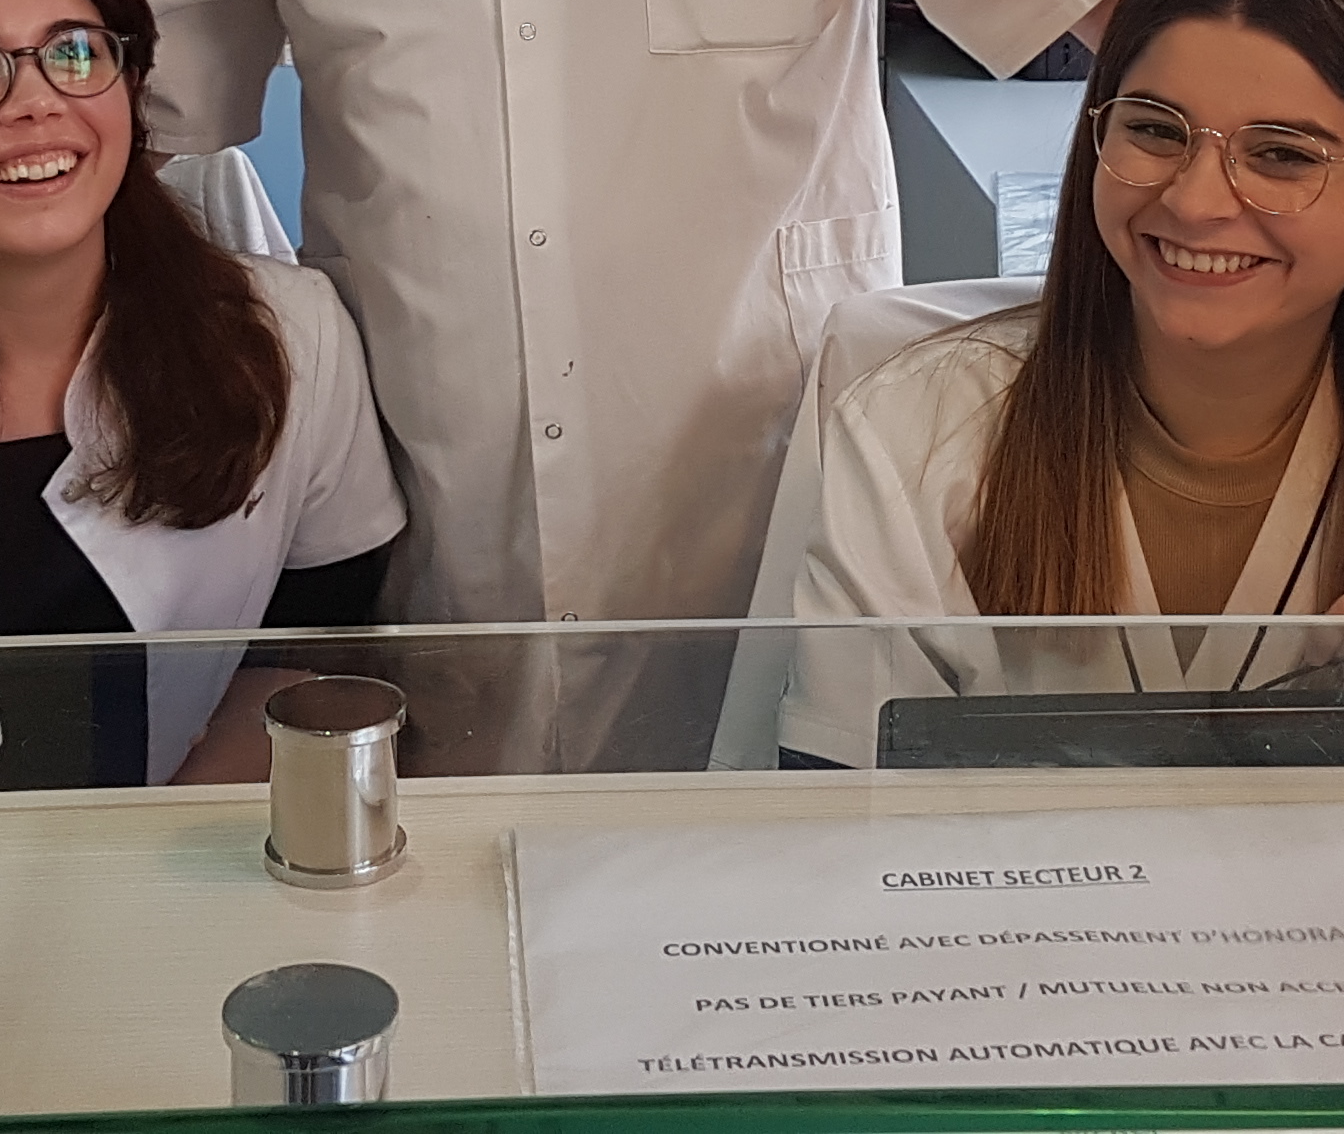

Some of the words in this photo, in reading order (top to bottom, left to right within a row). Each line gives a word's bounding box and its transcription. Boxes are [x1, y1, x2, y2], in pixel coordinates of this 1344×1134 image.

[882, 870, 995, 888] CABINET
[1003, 865, 1124, 885] SECTEUR
[1129, 864, 1147, 880] 2
[662, 934, 890, 957] CONVENTIONNÉ
[899, 934, 972, 950] AVEC
[978, 928, 1182, 947] DÉPASSEMENT
[695, 997, 750, 1012] PAS
[758, 996, 797, 1010] DE
[802, 991, 884, 1008] TIERS
[891, 984, 1007, 1005] PAYANT
[1017, 982, 1029, 1000] /
[1039, 980, 1195, 996] MUTUELLE
[1201, 981, 1270, 994] NON
[637, 1047, 939, 1074] TÉLÉTRANSMISSION
[948, 1037, 1180, 1062] AUTOMATIQUE
[1189, 1034, 1269, 1051] AVEC
[1273, 1034, 1314, 1049] LA
